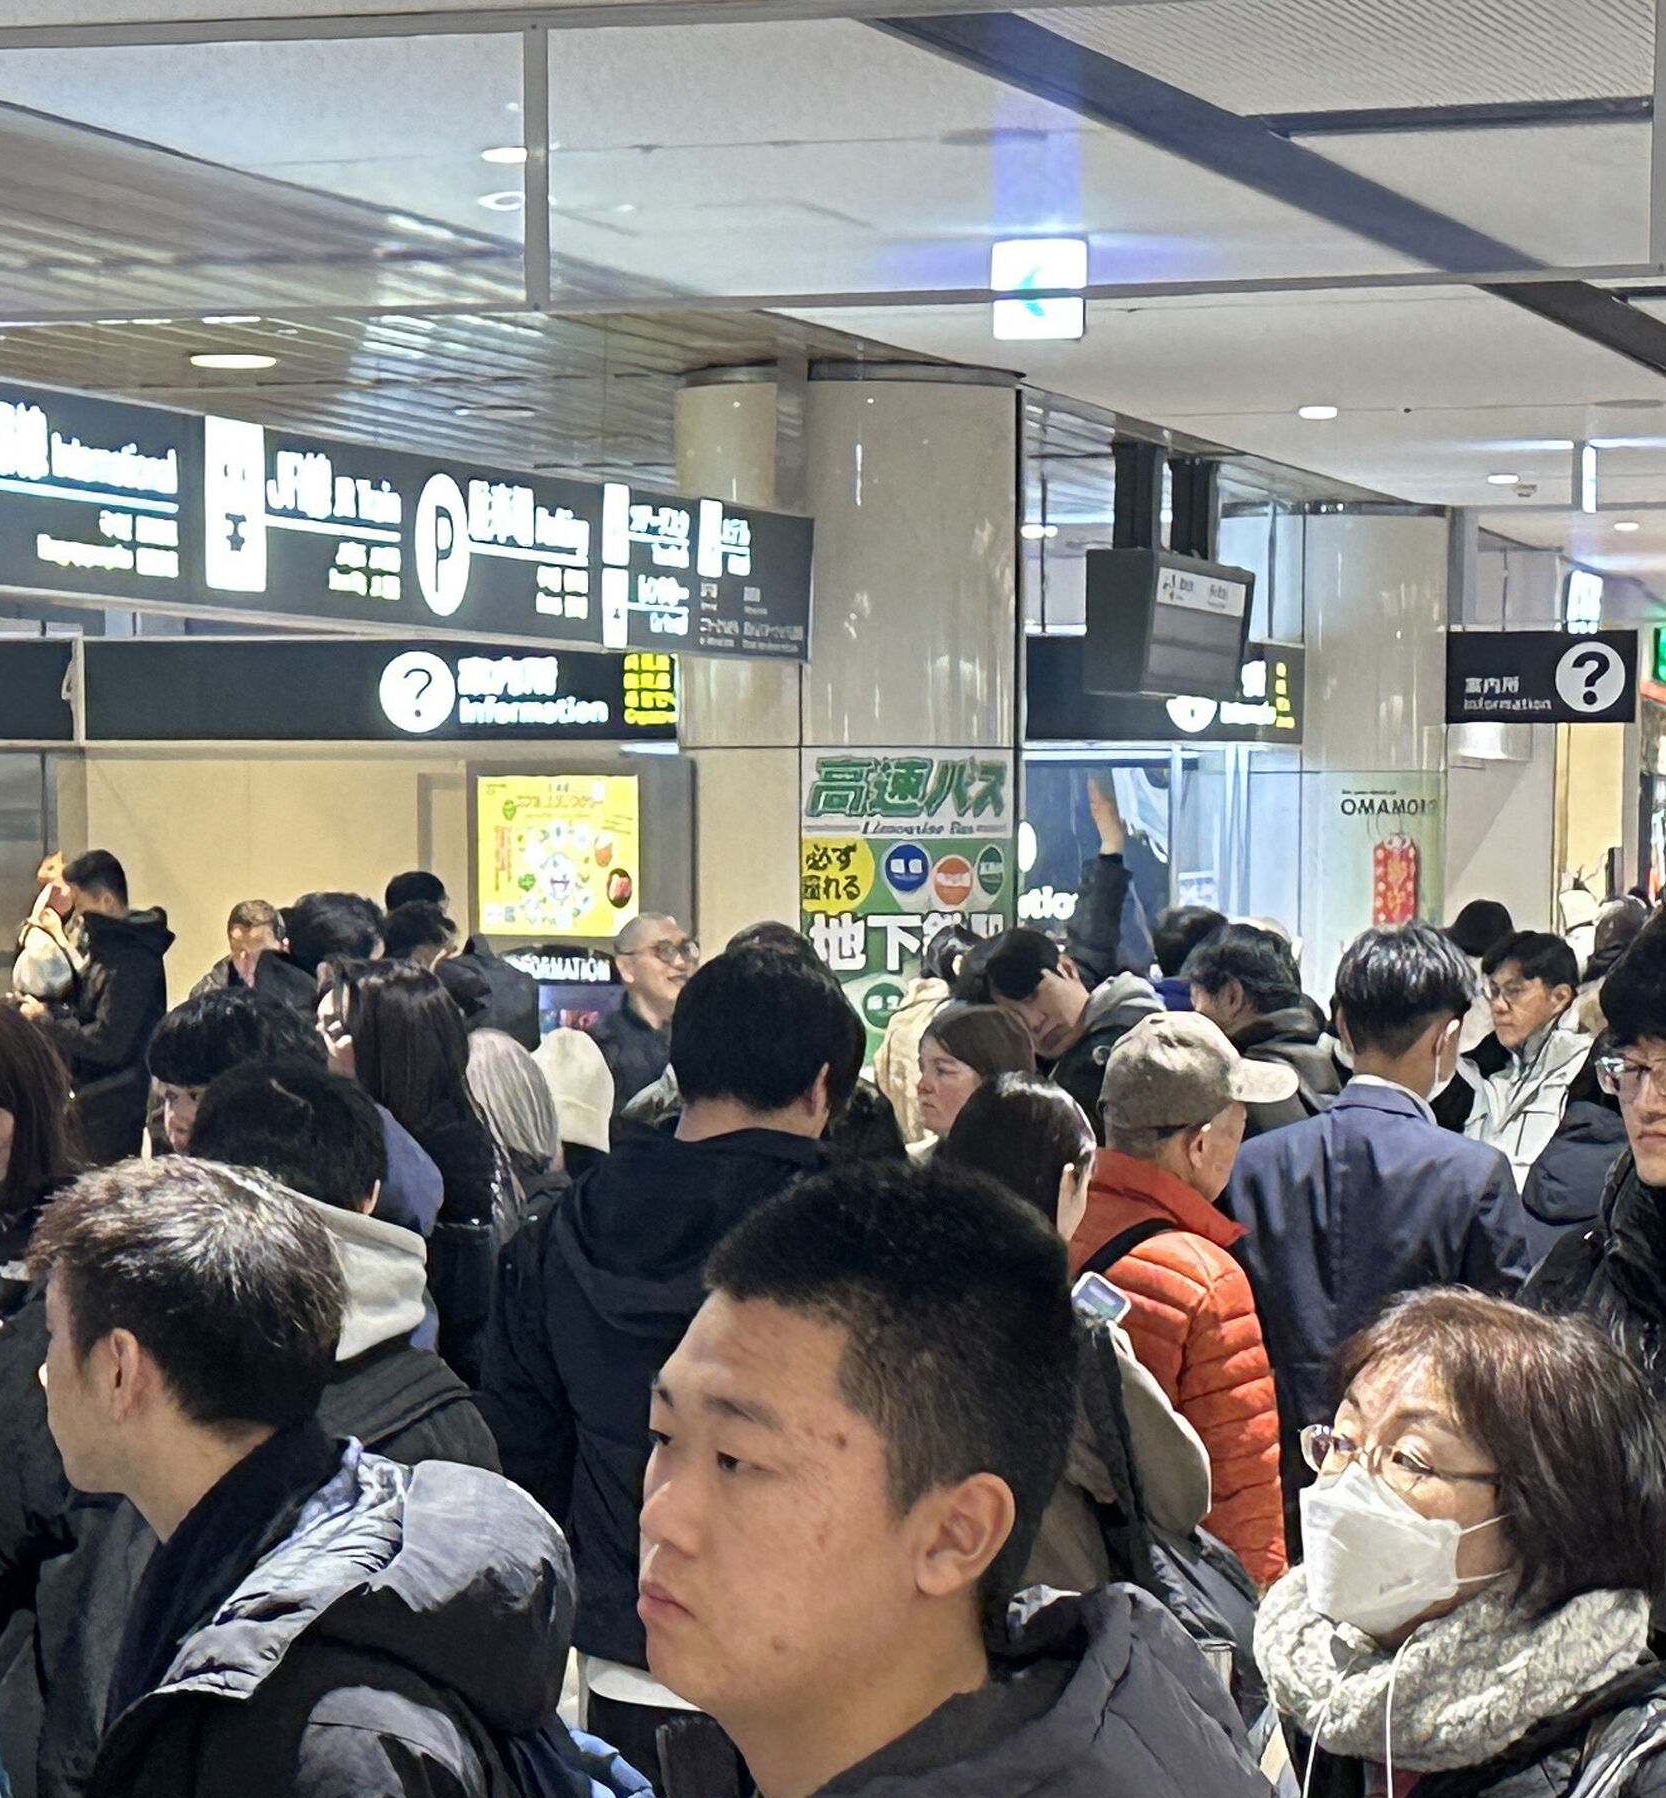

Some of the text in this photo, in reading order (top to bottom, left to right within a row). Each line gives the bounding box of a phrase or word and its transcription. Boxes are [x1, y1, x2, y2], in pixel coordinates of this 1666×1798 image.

[1463, 696, 1552, 711] Information
[805, 756, 1008, 818] 高速バス
[805, 843, 857, 872] 必ず
